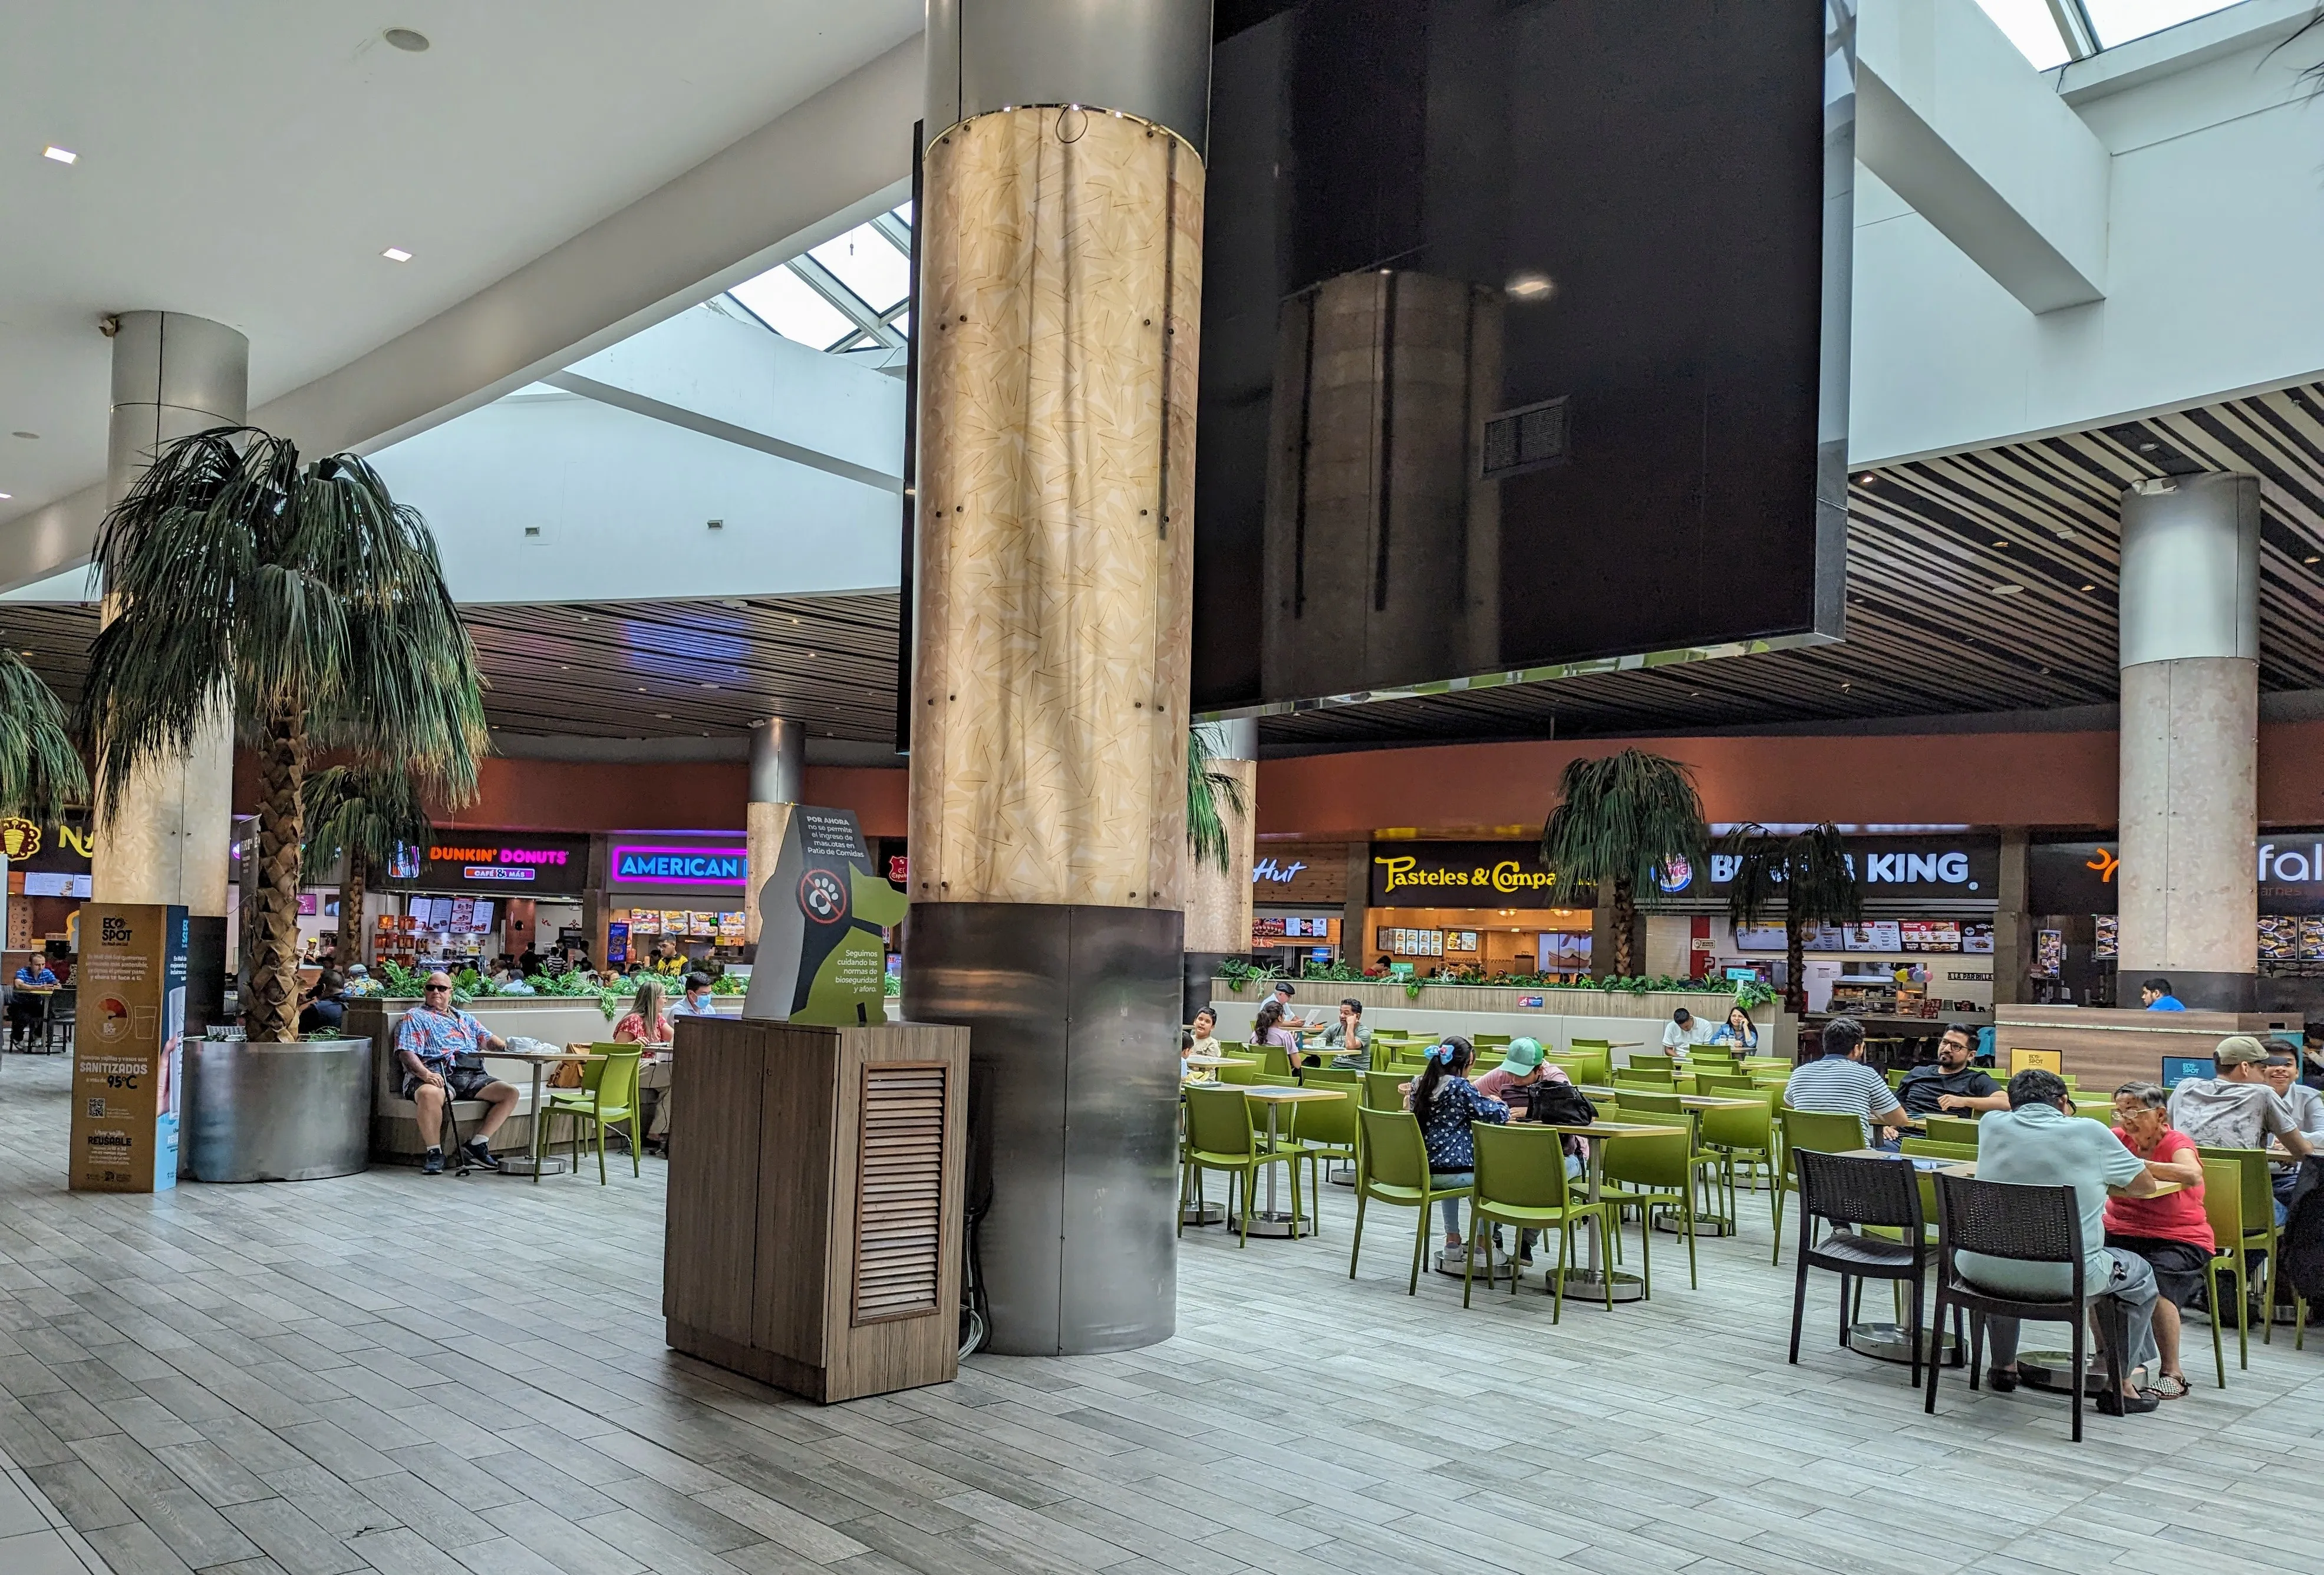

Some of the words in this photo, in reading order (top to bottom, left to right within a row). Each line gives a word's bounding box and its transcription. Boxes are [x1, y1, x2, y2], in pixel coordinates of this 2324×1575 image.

[824, 817, 849, 826] AHORA
[819, 831, 843, 840] ingreso
[430, 847, 497, 862] DUNKIN'
[500, 850, 566, 864] DONUTS
[836, 849, 864, 857] Comidas
[621, 857, 737, 877] AMERICAN
[1253, 858, 1307, 883] Hut
[1868, 853, 1968, 883] KING
[1375, 856, 1468, 893] Pasteles
[1471, 868, 1489, 886] &
[103, 917, 126, 929] ECO
[102, 930, 133, 941] SPOT
[846, 950, 878, 958] Seguimos
[835, 976, 878, 985] bioseguridad
[80, 1062, 149, 1075] SANITIZADOS
[88, 1136, 133, 1147] REUSABLE
